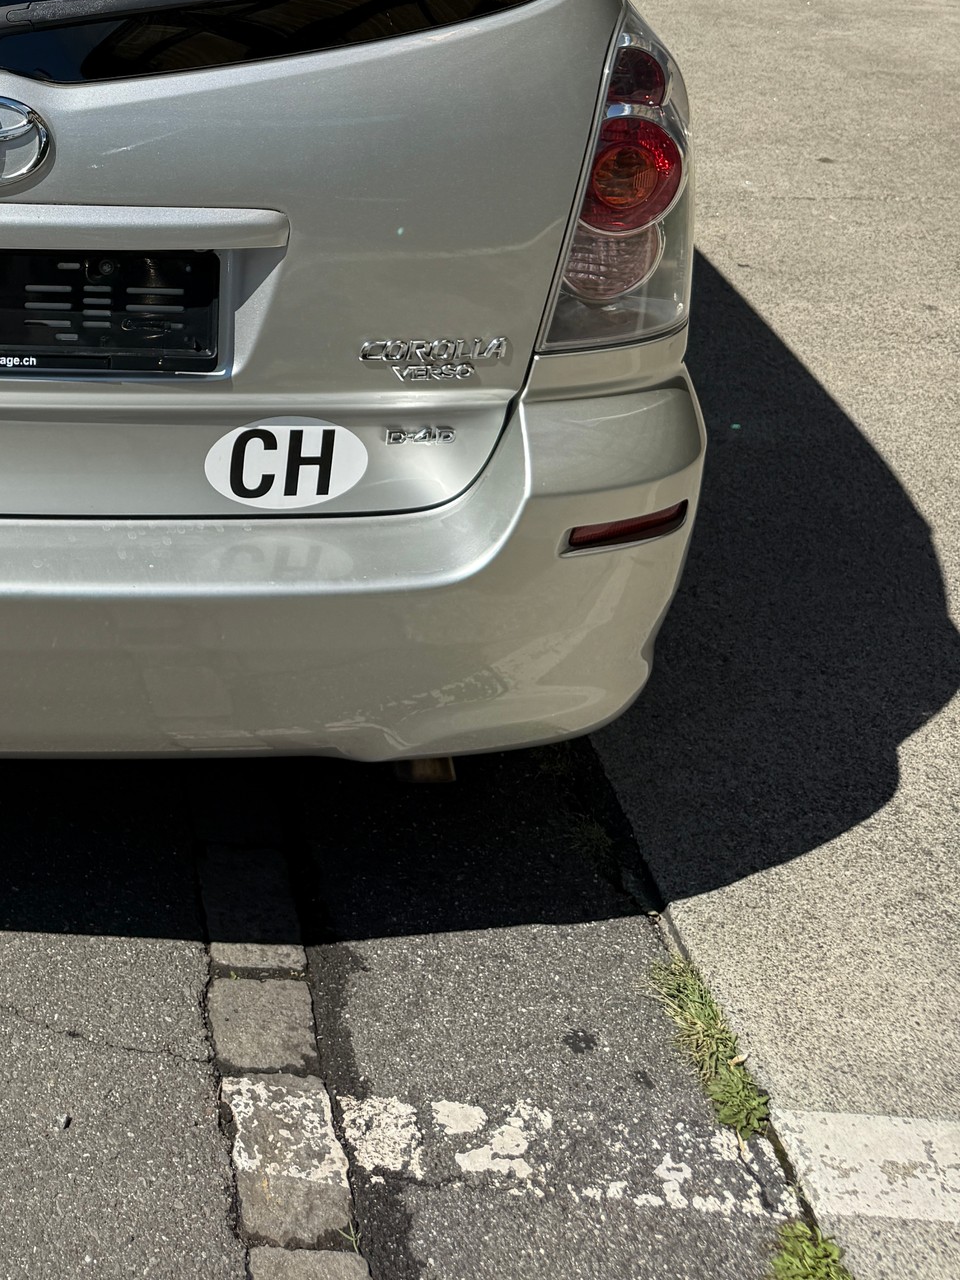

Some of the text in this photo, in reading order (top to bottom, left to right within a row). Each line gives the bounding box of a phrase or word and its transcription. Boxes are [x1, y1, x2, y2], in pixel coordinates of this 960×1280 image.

[358, 336, 509, 362] COROLLA
[391, 362, 476, 382] VERSO
[229, 428, 336, 499] CH
